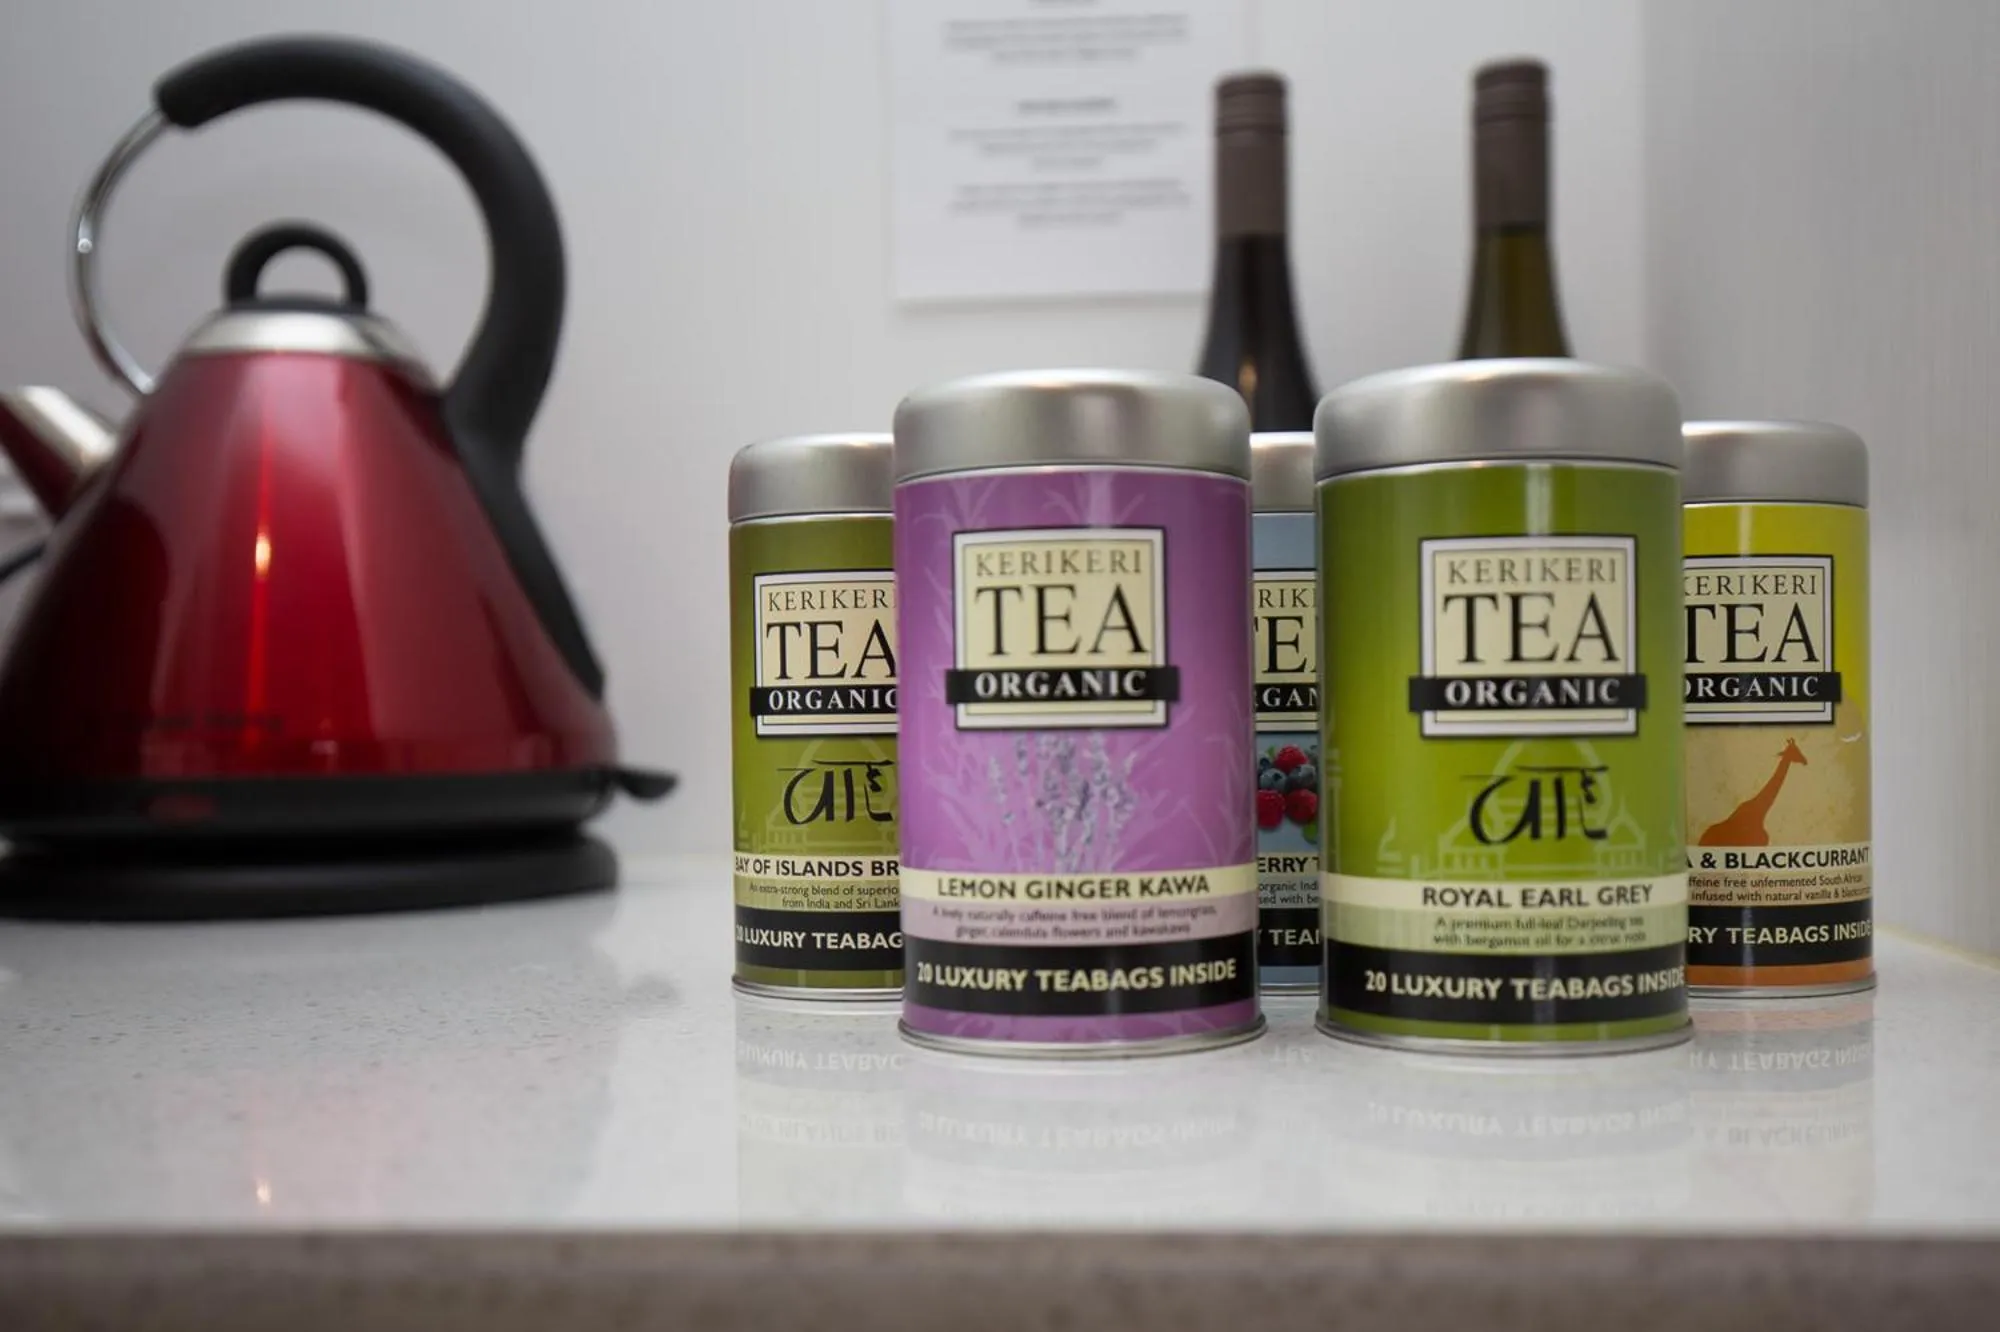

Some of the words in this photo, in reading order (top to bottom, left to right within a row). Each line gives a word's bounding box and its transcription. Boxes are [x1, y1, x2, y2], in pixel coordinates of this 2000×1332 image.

[976, 549, 1142, 577] KERIKERI
[1448, 557, 1617, 584] KERIKERI
[1684, 575, 1817, 597] ERIKERI
[767, 588, 896, 612] KERIKER
[974, 582, 1149, 656] TEA
[1442, 592, 1620, 664] TEA
[1684, 602, 1820, 663] TEA
[765, 618, 897, 680] TEA
[974, 670, 1147, 698] ORGANIC
[1445, 679, 1620, 707] ORGANIC
[768, 688, 897, 710] ORGANIC
[753, 858, 771, 875] OF
[776, 860, 863, 877] ISLANDS
[1700, 853, 1716, 868] &
[1725, 847, 1870, 869] BLACKCURRANT
[811, 885, 840, 896] blend
[843, 885, 854, 896] of
[937, 879, 1016, 898] LEMON
[1026, 879, 1131, 898] GINGER
[1138, 875, 1210, 897] KAWA
[1724, 876, 1747, 888] free
[1751, 875, 1817, 889] unfermented
[1819, 873, 1843, 885] South
[782, 898, 804, 909] from
[806, 898, 830, 910] India
[834, 899, 853, 909] and
[856, 898, 871, 909] Sri
[1279, 895, 1303, 904] with
[1423, 886, 1510, 908] ROYAL
[1521, 889, 1589, 907] EARL
[1597, 884, 1654, 905] GREY
[1692, 890, 1733, 902] infused
[1737, 890, 1762, 901] with
[1765, 889, 1802, 901] natural
[1805, 887, 1832, 900] vanilla
[744, 930, 807, 947] LUXURY
[1105, 924, 1129, 937] and
[1725, 926, 1829, 945] TEABAGS
[917, 961, 933, 983] 20
[935, 967, 1028, 990] LUXURY
[1034, 967, 1164, 992] TEABAGS
[1170, 958, 1237, 982] INSIDE
[1365, 970, 1387, 992] 20
[1391, 975, 1502, 998] LUXURY
[1510, 976, 1634, 1000] TEABAGS
[1638, 969, 1685, 993] INSIDE
